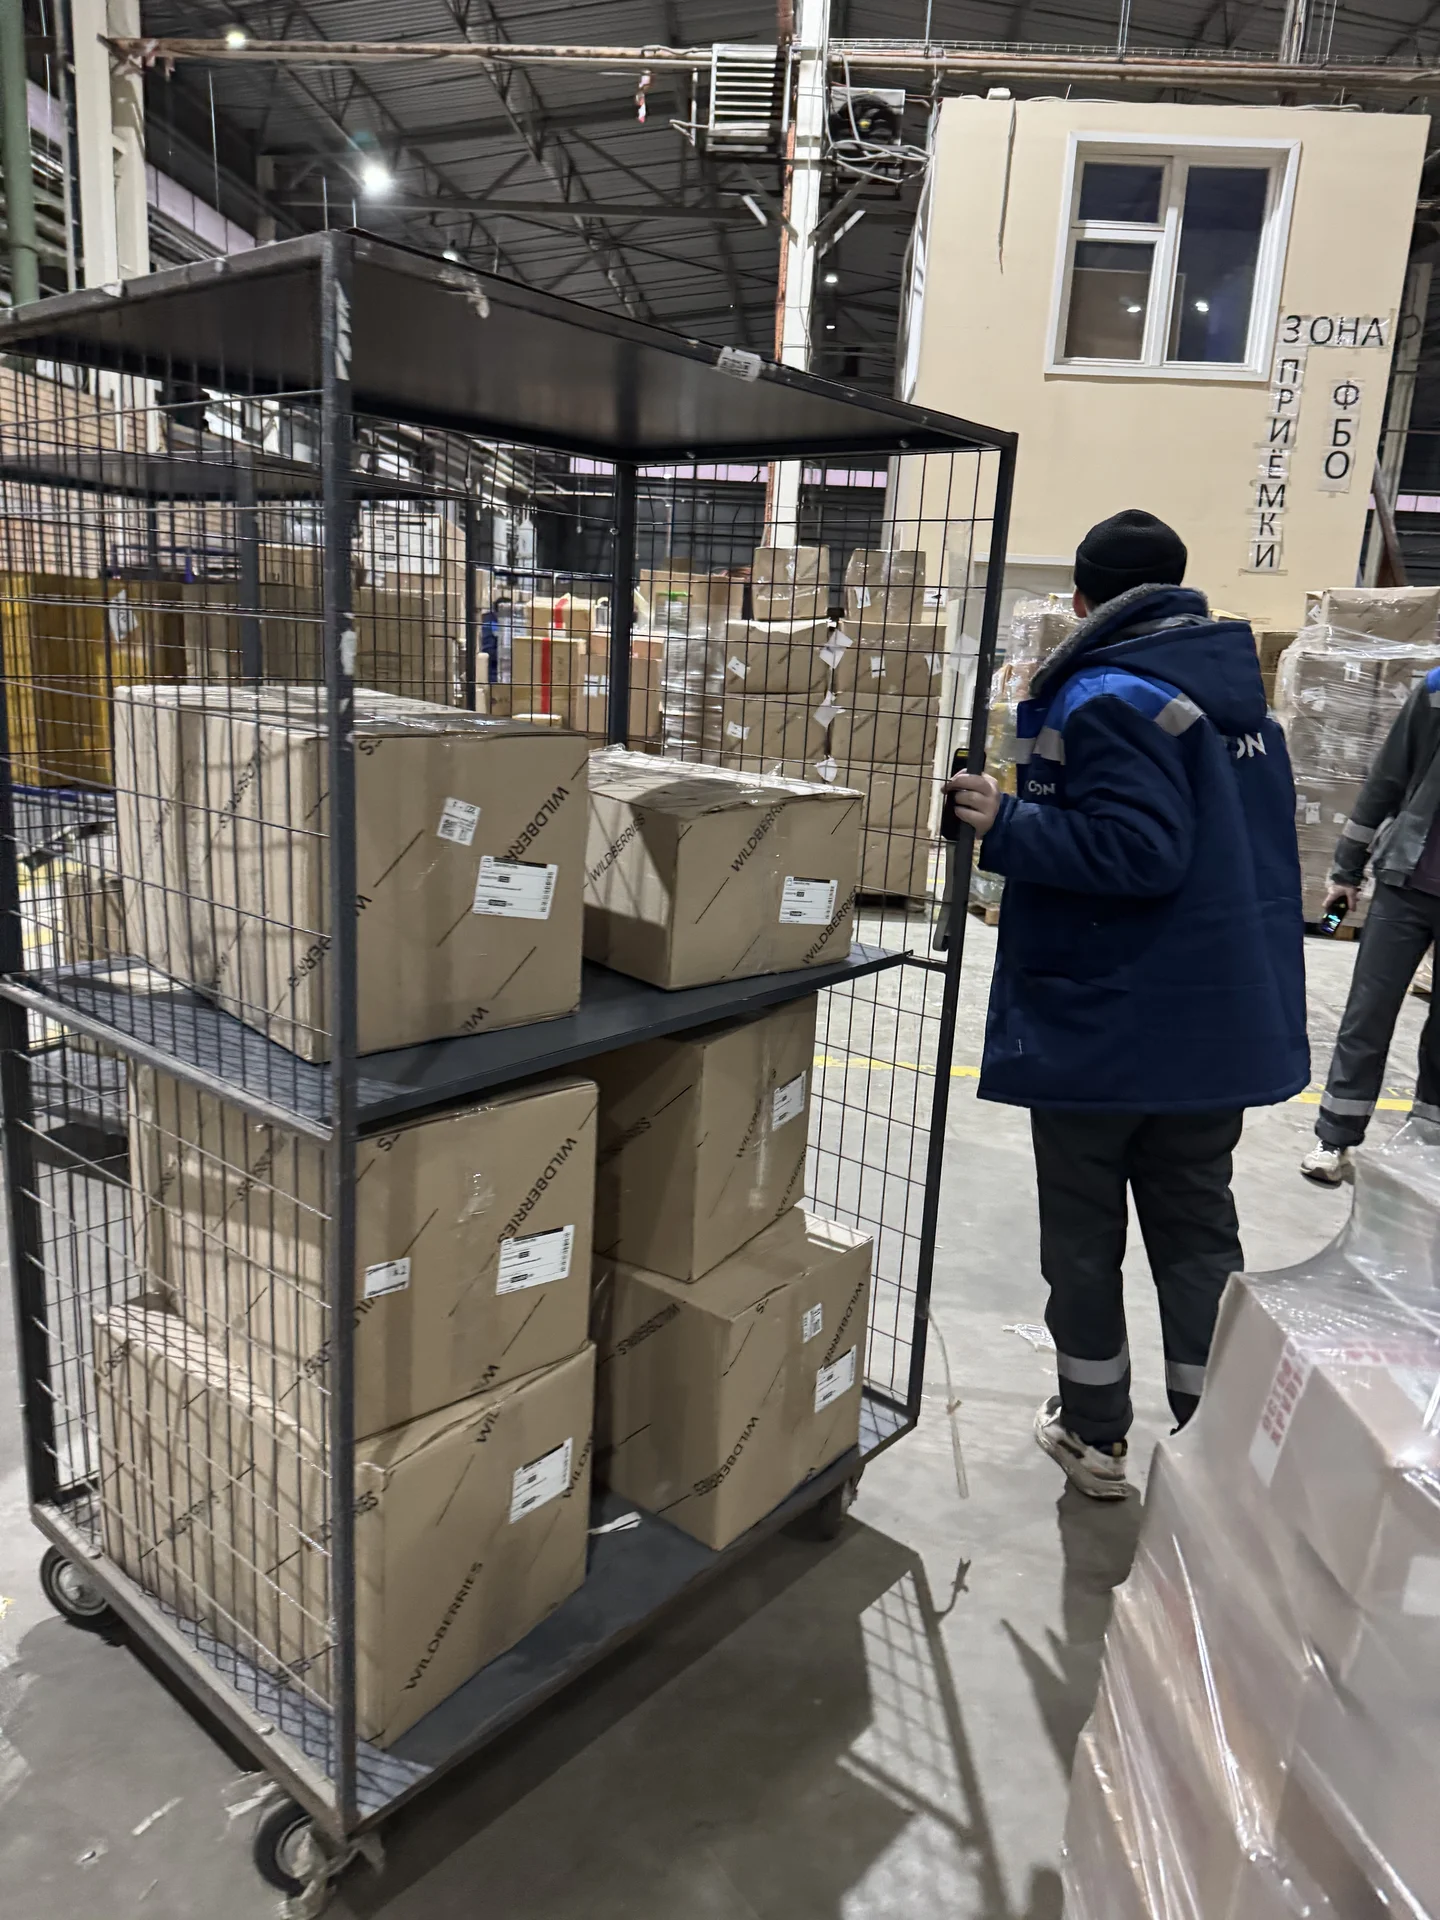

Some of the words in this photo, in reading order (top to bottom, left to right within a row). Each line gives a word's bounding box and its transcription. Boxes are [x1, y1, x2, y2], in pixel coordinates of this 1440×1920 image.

[1283, 315, 1383, 346] ЗОНА
[1254, 358, 1300, 569] ПРИЁМКИ
[1324, 380, 1360, 480] ФБО
[590, 813, 646, 882] WILDBERRIES
[401, 1561, 483, 1691] WILDBERRIES
